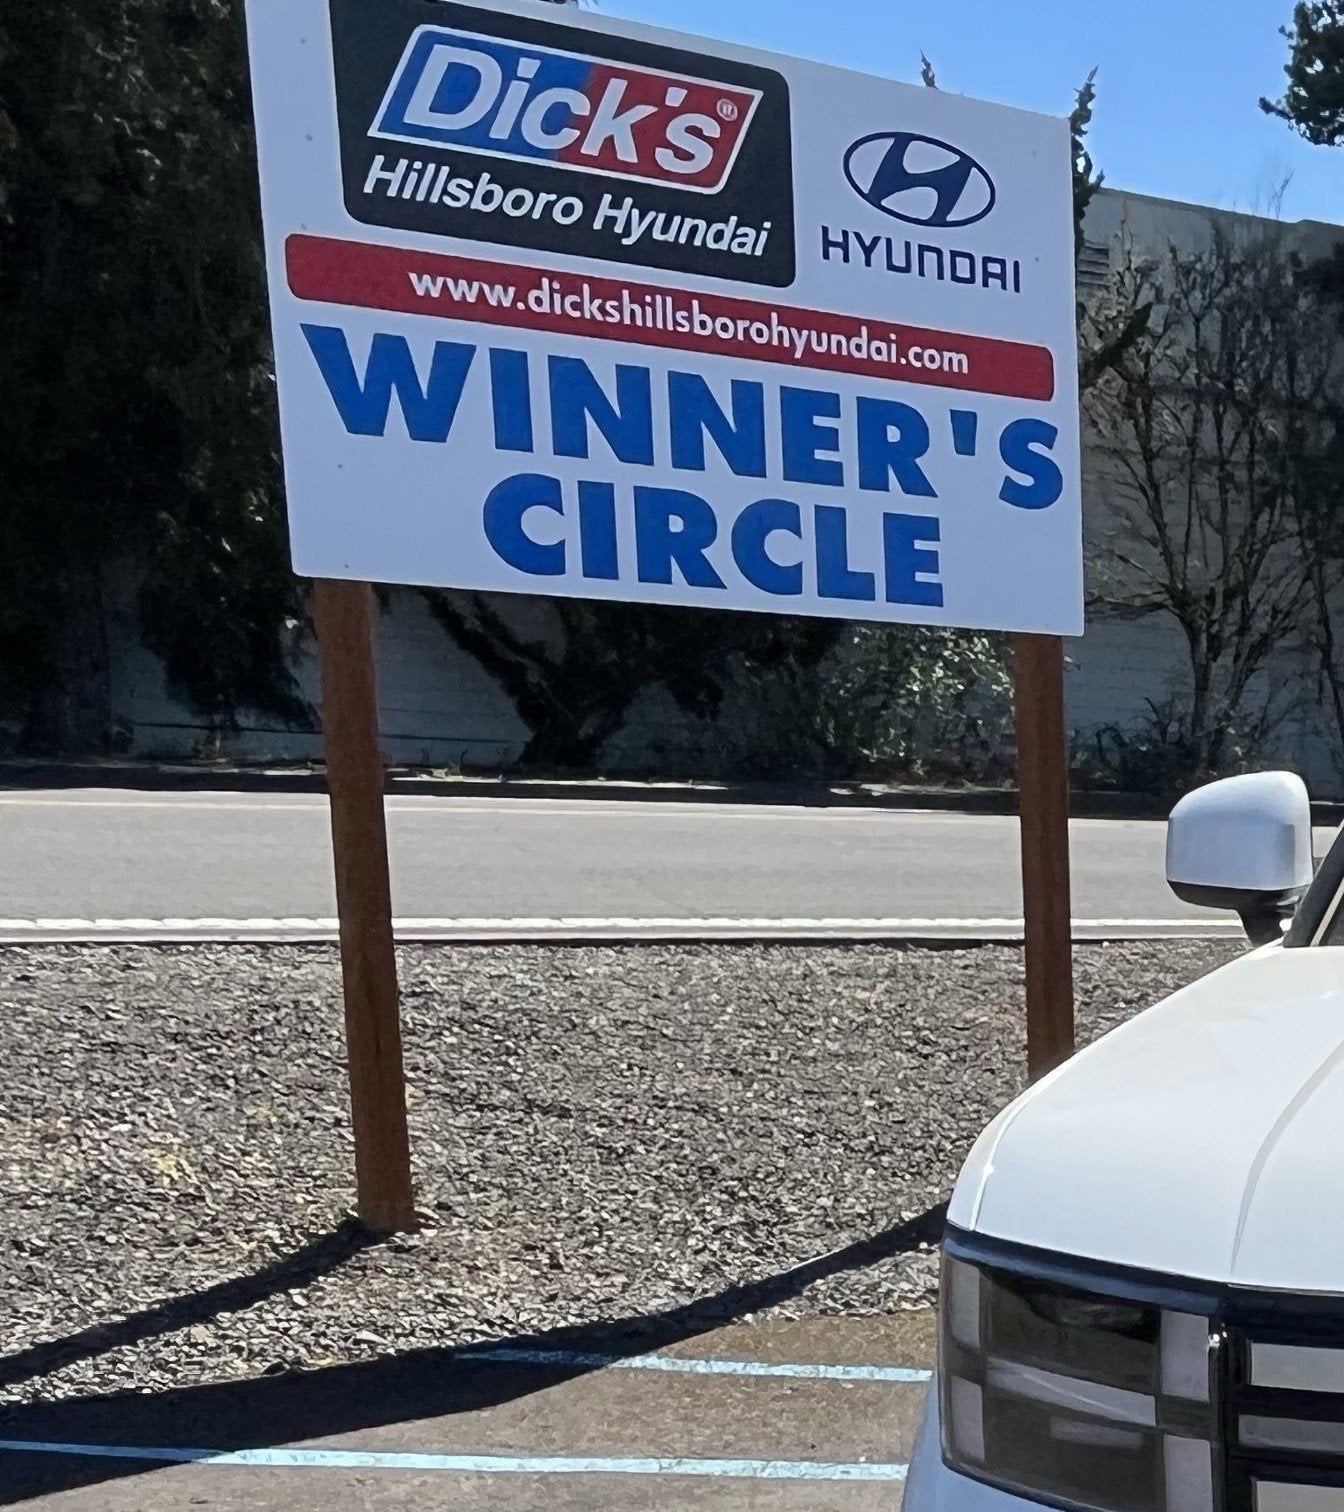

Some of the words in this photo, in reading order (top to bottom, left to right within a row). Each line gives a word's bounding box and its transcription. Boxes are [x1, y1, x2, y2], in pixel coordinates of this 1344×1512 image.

[402, 44, 722, 174] Dick's
[363, 155, 584, 225] Hillsboro
[593, 194, 771, 256] Hyundai
[821, 226, 1022, 293] HYUNDAI
[408, 270, 969, 374] www.dickshillsborohyundai.com
[299, 323, 1064, 510] WINNER'S
[483, 472, 944, 608] CIRCLE
